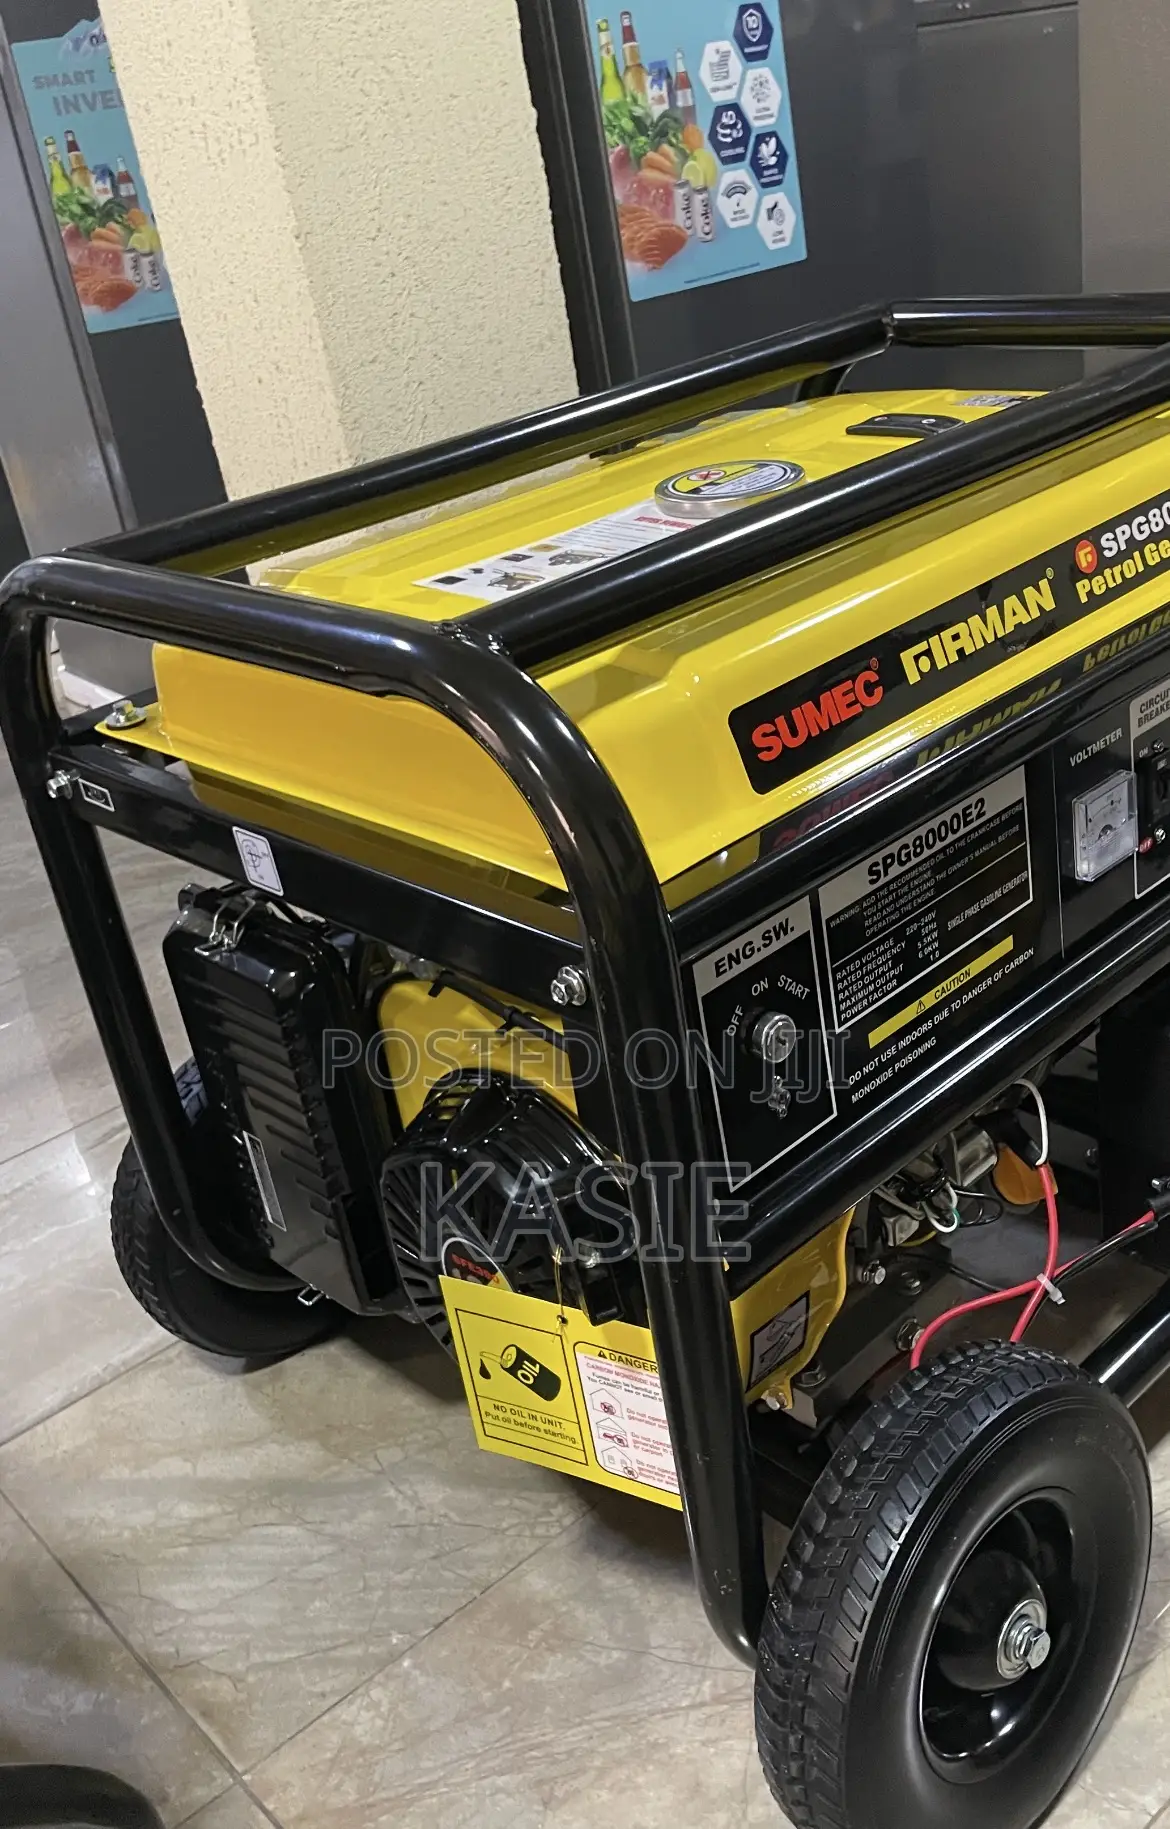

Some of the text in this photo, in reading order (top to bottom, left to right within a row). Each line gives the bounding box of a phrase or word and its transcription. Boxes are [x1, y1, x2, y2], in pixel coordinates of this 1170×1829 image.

[32, 69, 95, 90] SMART
[52, 89, 124, 116] INVE
[1076, 551, 1144, 604] Petrol
[1140, 688, 1170, 713] CIRCUI
[1069, 727, 1123, 767] VOLTMETER
[862, 895, 877, 909] ADD
[877, 887, 889, 899] THE
[889, 858, 935, 890] RECOMMENDED
[946, 845, 954, 856] TO
[955, 838, 966, 850] THE
[967, 816, 1001, 844] CRANKCASE
[1001, 802, 1023, 822] BEFORE
[867, 797, 986, 885] SPG8000E2
[864, 913, 881, 927] READ
[882, 904, 895, 917] AND
[896, 880, 935, 908] UNDERSTAND
[936, 870, 947, 881] THE
[975, 840, 997, 857] MANUAL
[998, 823, 1020, 843] BEFORE
[863, 905, 876, 918] YOU
[877, 893, 896, 908] START
[897, 886, 909, 899] THE
[865, 911, 900, 937] OPERATING
[901, 902, 912, 914] THE
[947, 870, 1028, 931] SINGLE PHASE GASOLINE GENERATOR
[714, 917, 795, 978] ENG.SW.
[836, 960, 861, 980] RATED
[861, 937, 895, 963] VOLTAGE
[837, 970, 862, 990] RATED
[863, 940, 906, 975] FREQUENCY
[752, 977, 769, 996] ON
[777, 974, 811, 1000] START
[838, 981, 863, 1001] RATED
[863, 960, 893, 984] OUTPUT
[839, 983, 875, 1012] MAXIMUM
[875, 963, 904, 987] OUTPUT
[841, 999, 868, 1022] POWER
[869, 979, 898, 1003] FACTOR
[934, 967, 972, 1000] CAUTION
[727, 1004, 744, 1037] OFF
[849, 947, 1035, 1085] DO NOT USE INDOORS DUE TO DANGER OF CARBON
[851, 1036, 937, 1103] MONOXIDE POISONING
[517, 1360, 540, 1385] OIL
[608, 1352, 659, 1374] DANGER
[484, 1410, 500, 1421] Put
[501, 1416, 511, 1425] oil
[513, 1419, 542, 1433] before
[492, 1403, 566, 1431] NO OIL IN UNIT.
